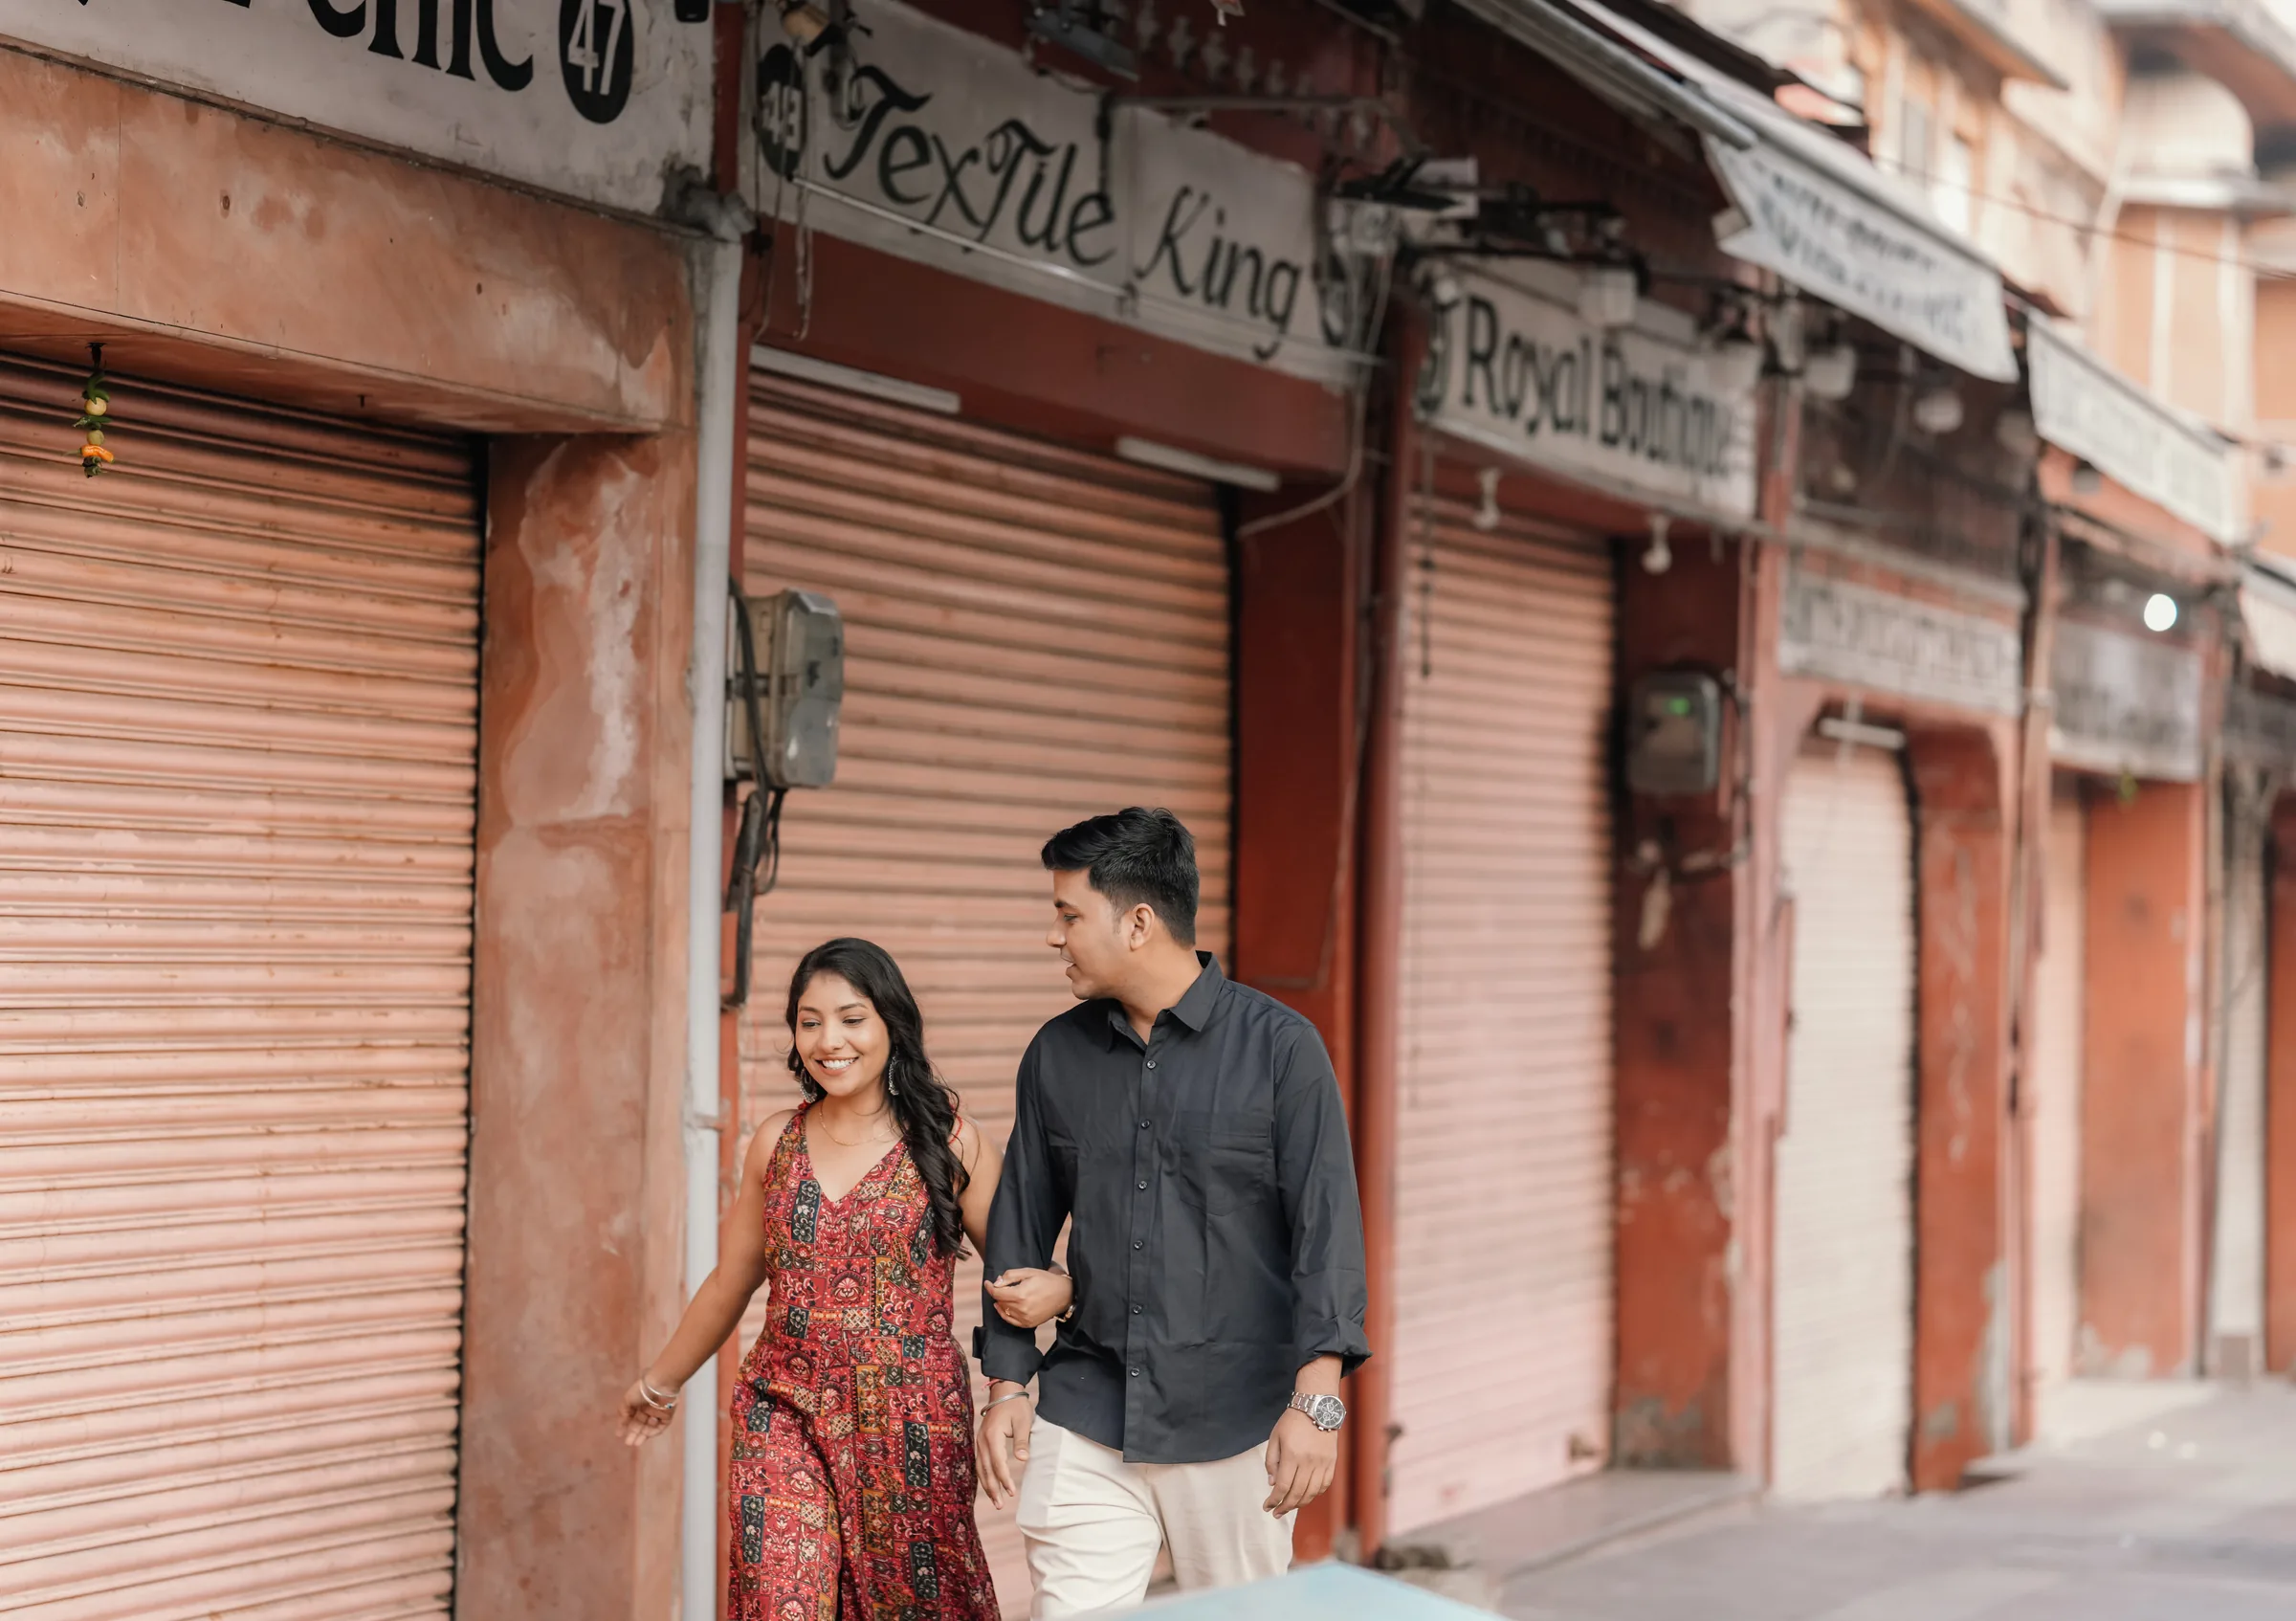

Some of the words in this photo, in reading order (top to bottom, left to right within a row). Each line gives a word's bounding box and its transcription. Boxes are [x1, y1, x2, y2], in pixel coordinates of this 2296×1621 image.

[567, 0, 627, 97] 47
[1136, 184, 1302, 360] King
[1463, 294, 1590, 437] Royal
[1601, 342, 1739, 477] Bout
